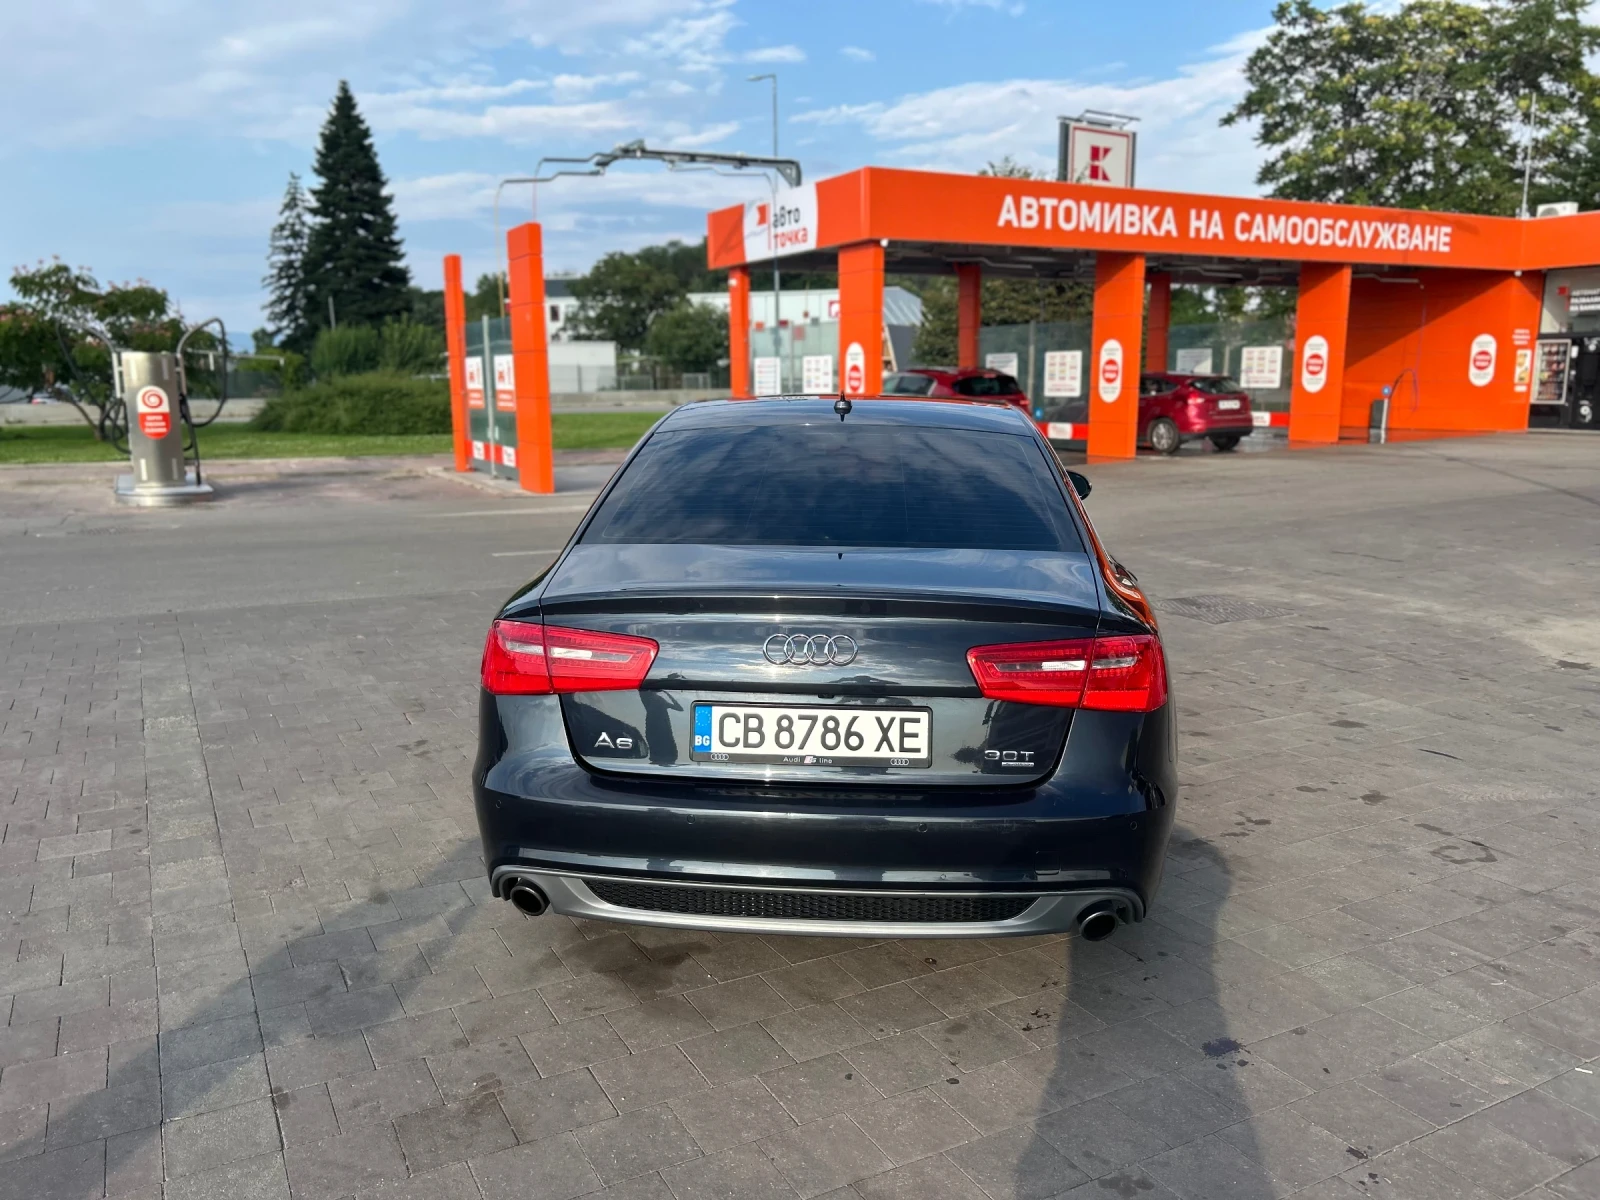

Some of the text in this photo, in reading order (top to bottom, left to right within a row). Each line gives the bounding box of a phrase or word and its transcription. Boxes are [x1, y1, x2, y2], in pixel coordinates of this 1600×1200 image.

[773, 205, 801, 229] авто
[997, 194, 1452, 253] АВТОМИВКА НА САМООБСЛУЖВАНЕ
[774, 226, 809, 248] точка
[593, 731, 633, 749] A6
[695, 735, 711, 746] BG
[718, 712, 922, 754] CB 8786 XE
